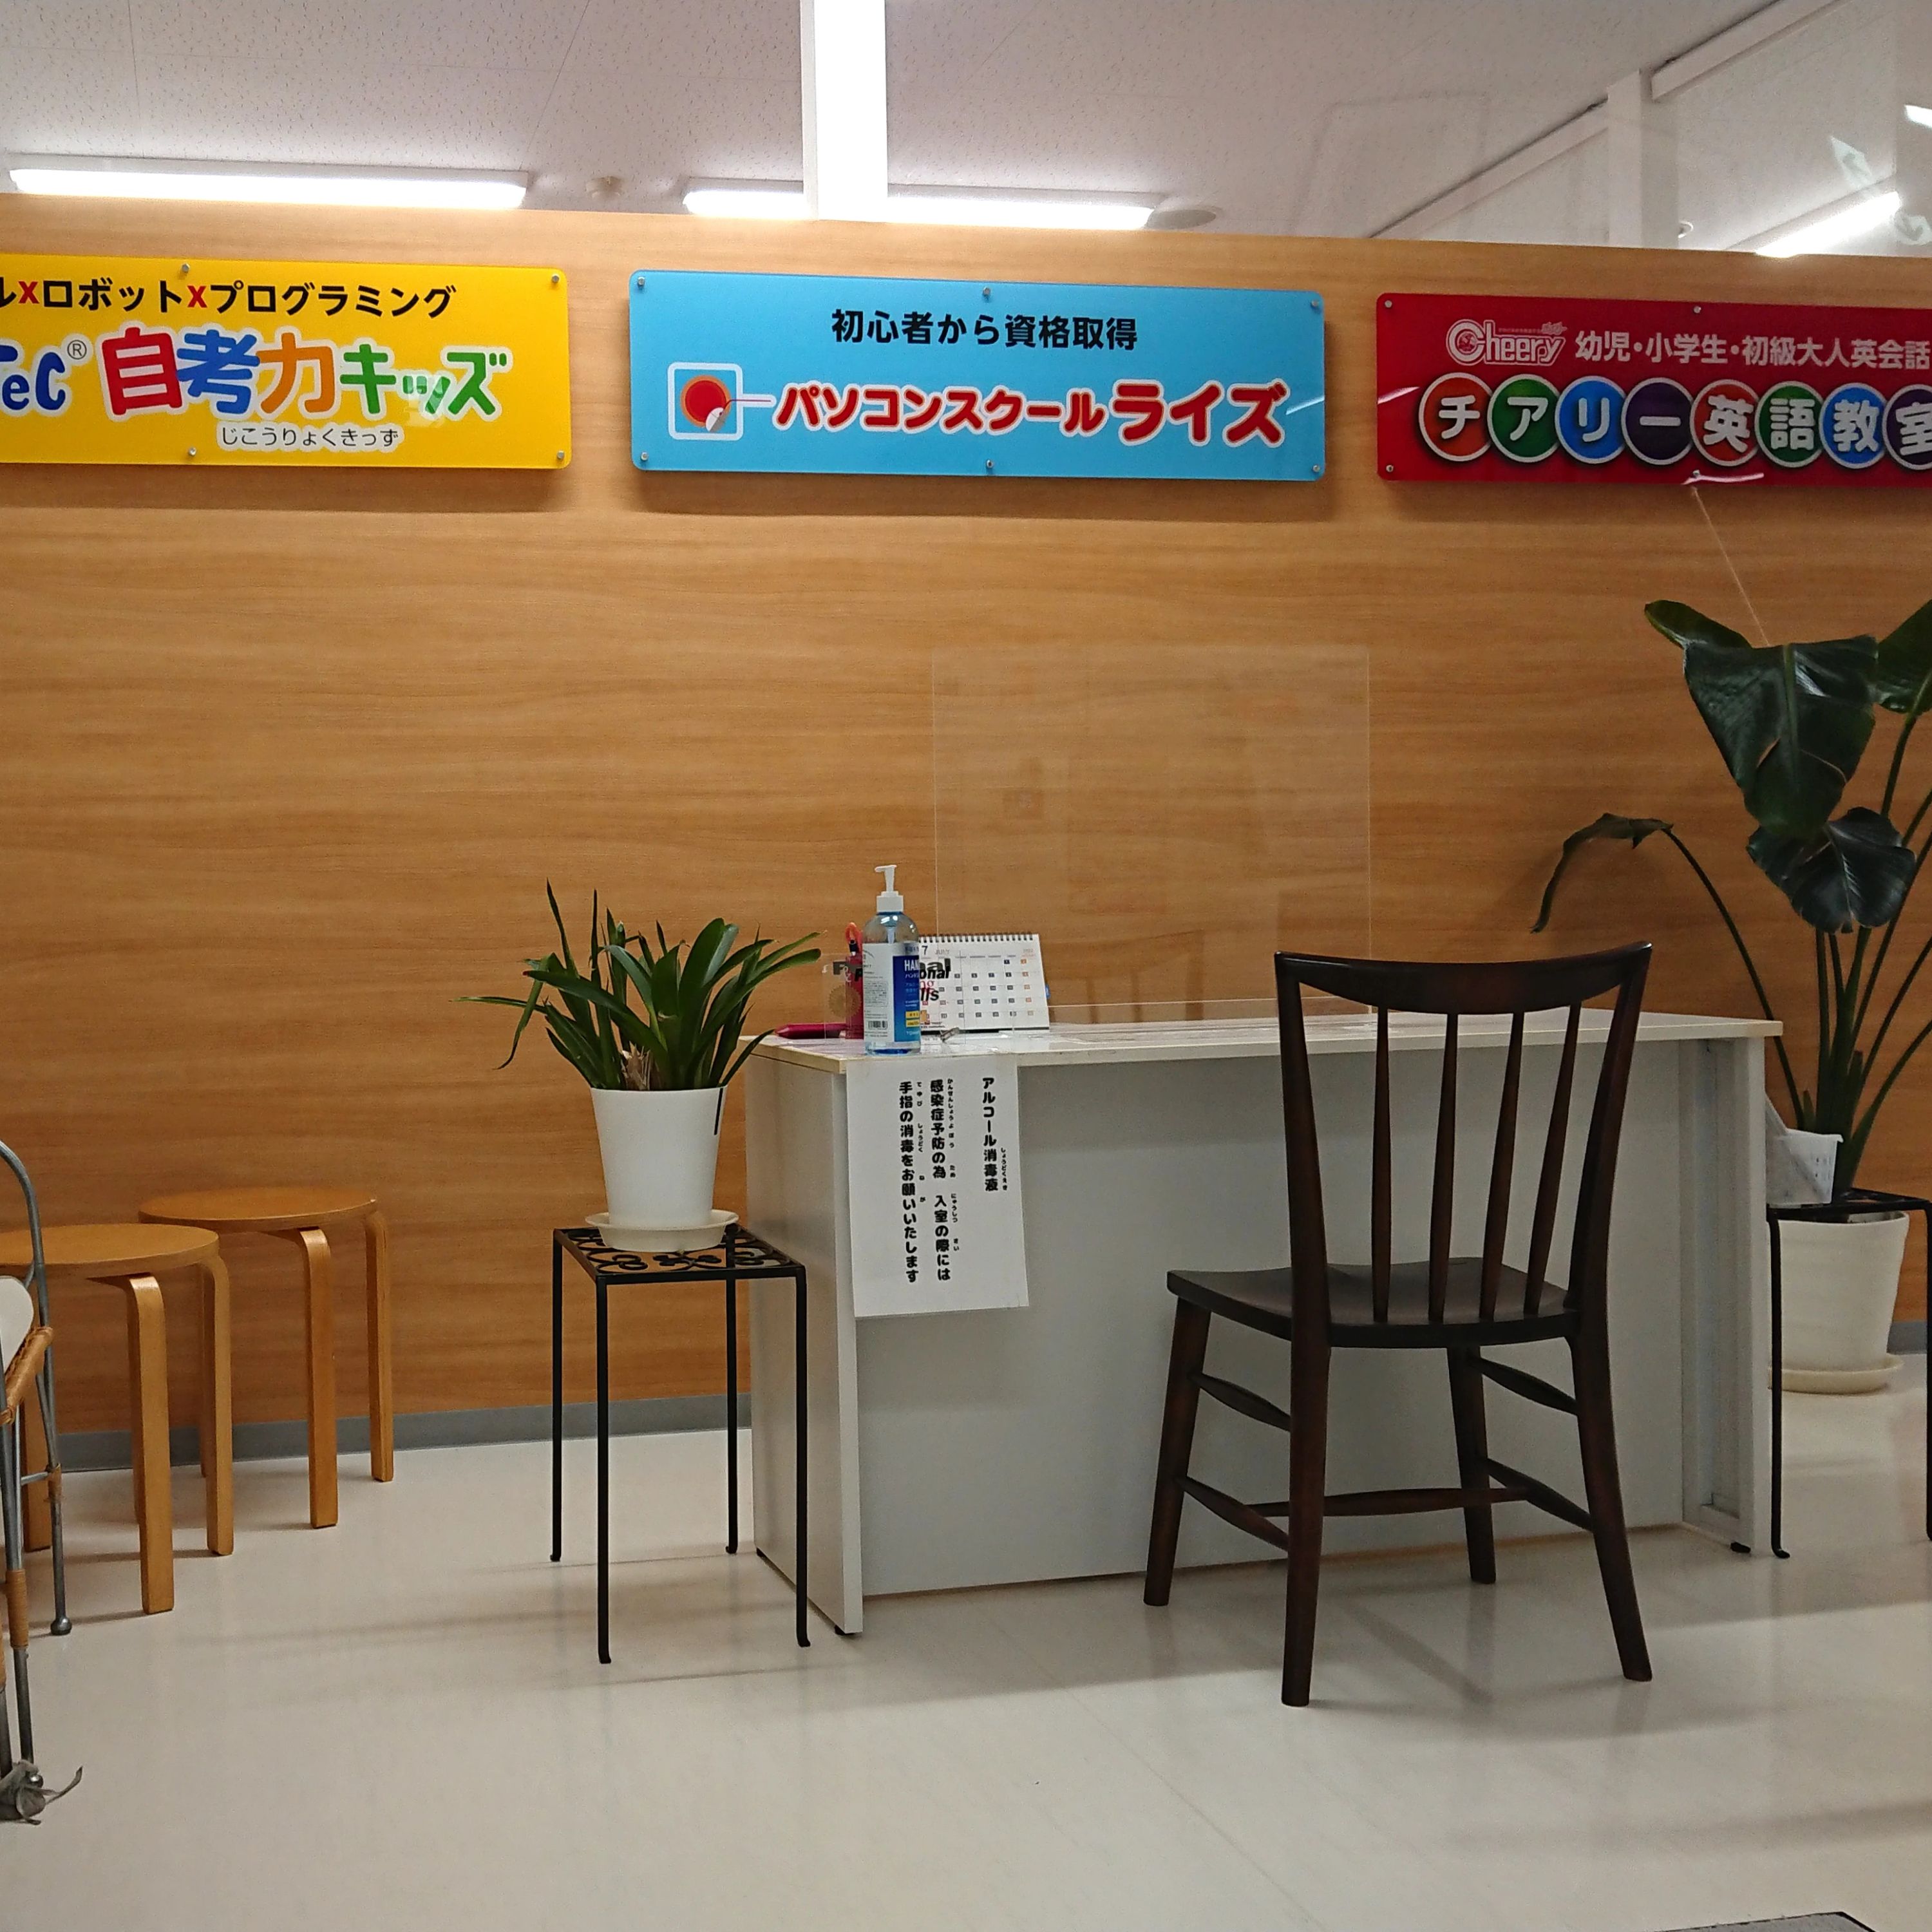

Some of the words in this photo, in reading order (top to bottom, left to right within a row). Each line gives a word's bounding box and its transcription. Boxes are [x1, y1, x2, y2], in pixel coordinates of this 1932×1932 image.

[831, 308, 1138, 351] 初心者から資格取得
[1446, 319, 1566, 366] Cheery
[1575, 330, 1931, 370] 幼児・小学生・初級大人英会話
[101, 327, 507, 416] 自考力キッズ
[222, 426, 399, 448] じこうりょくきっず
[922, 945, 928, 955] 7
[982, 1077, 998, 1191] アルコール消毒液
[898, 1081, 919, 1283] 手指の消毒をお願いいたします
